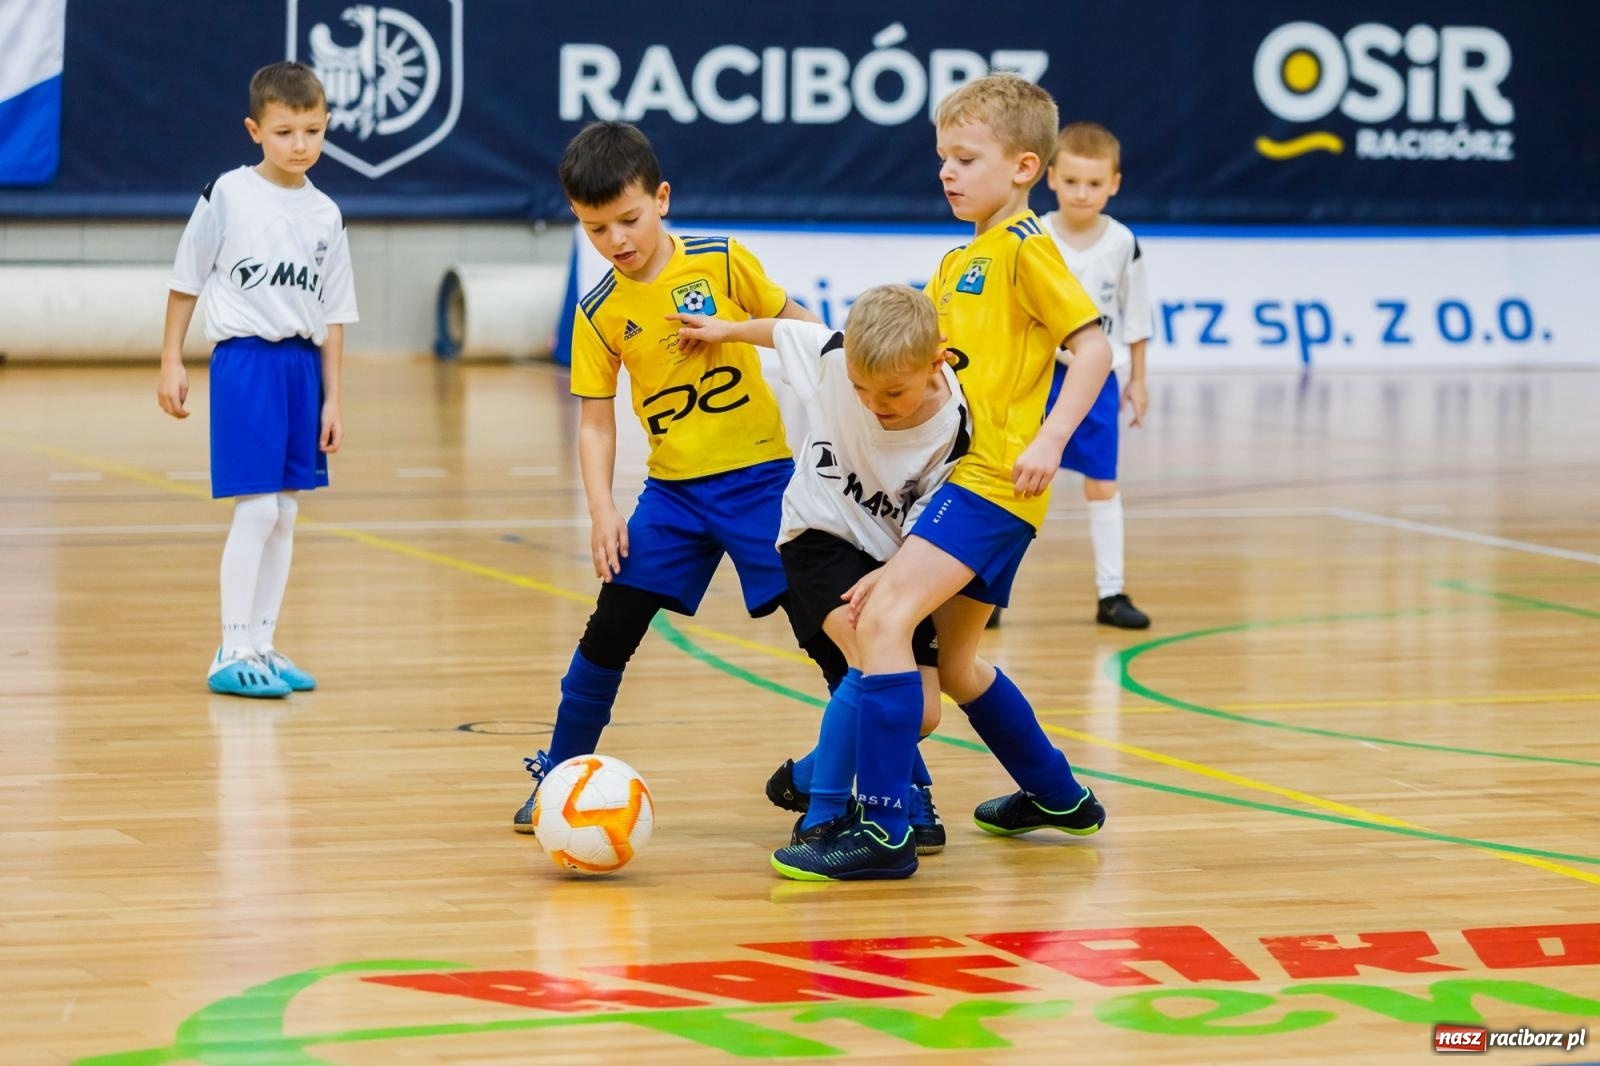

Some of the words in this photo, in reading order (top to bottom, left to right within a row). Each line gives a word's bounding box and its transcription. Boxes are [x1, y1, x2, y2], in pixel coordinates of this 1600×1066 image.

[1356, 121, 1514, 160] RACIBÓRZ
[1253, 299, 1353, 365] sp.
[1375, 300, 1413, 345] z
[1436, 298, 1554, 344] o.o.
[932, 499, 953, 524] KIPSTA
